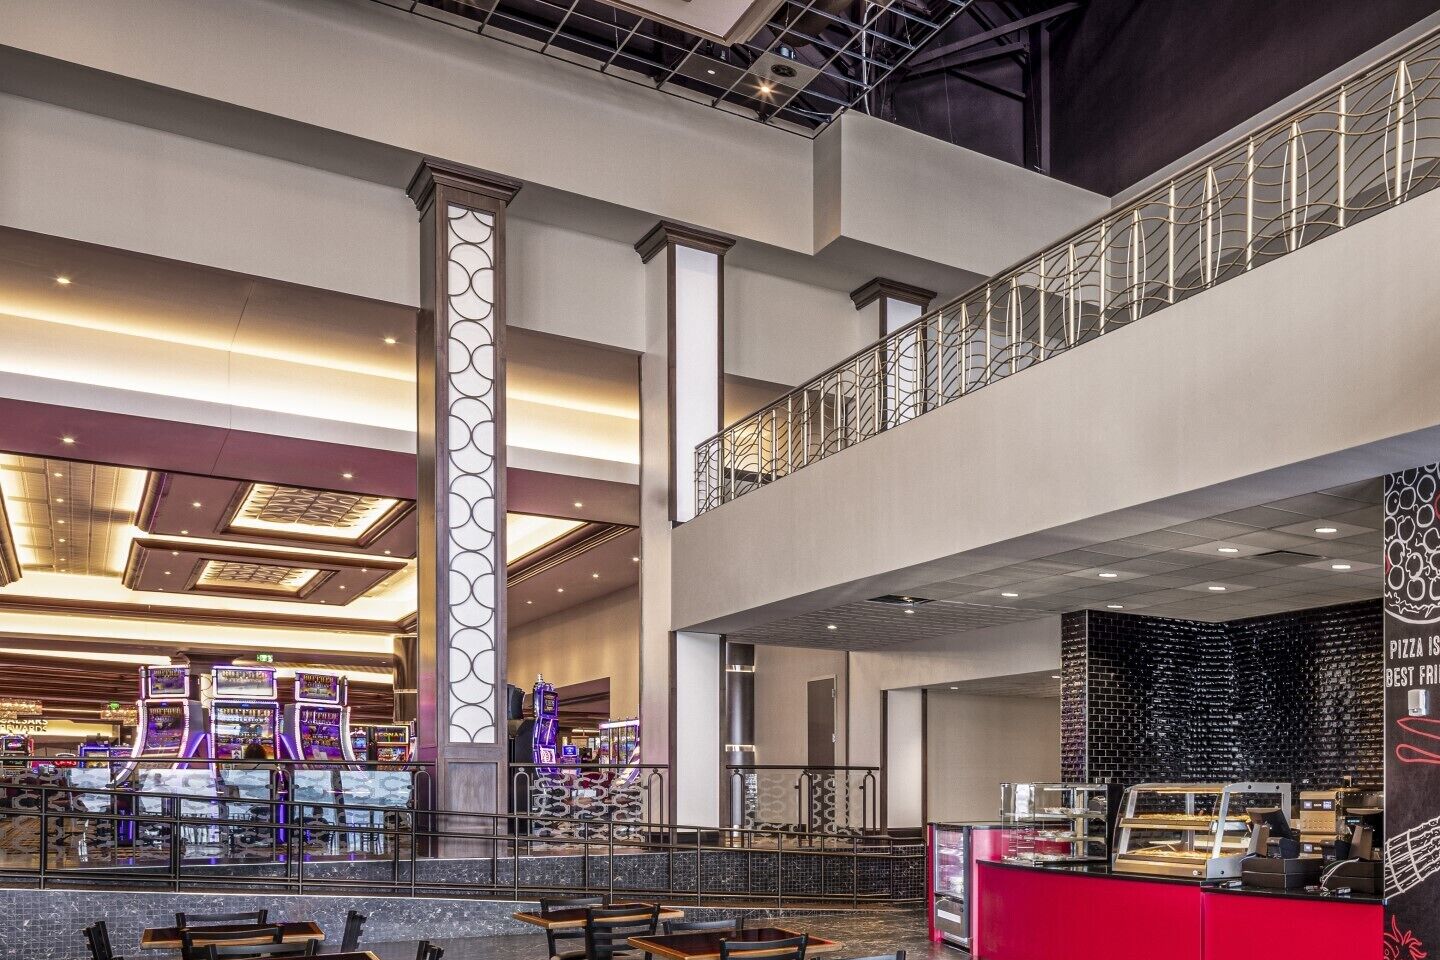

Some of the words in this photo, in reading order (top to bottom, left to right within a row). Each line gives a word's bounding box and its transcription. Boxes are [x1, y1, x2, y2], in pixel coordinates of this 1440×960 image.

[1389, 637, 1424, 660] PIZZA
[1428, 634, 1440, 657] IS
[1385, 665, 1415, 688] BEST
